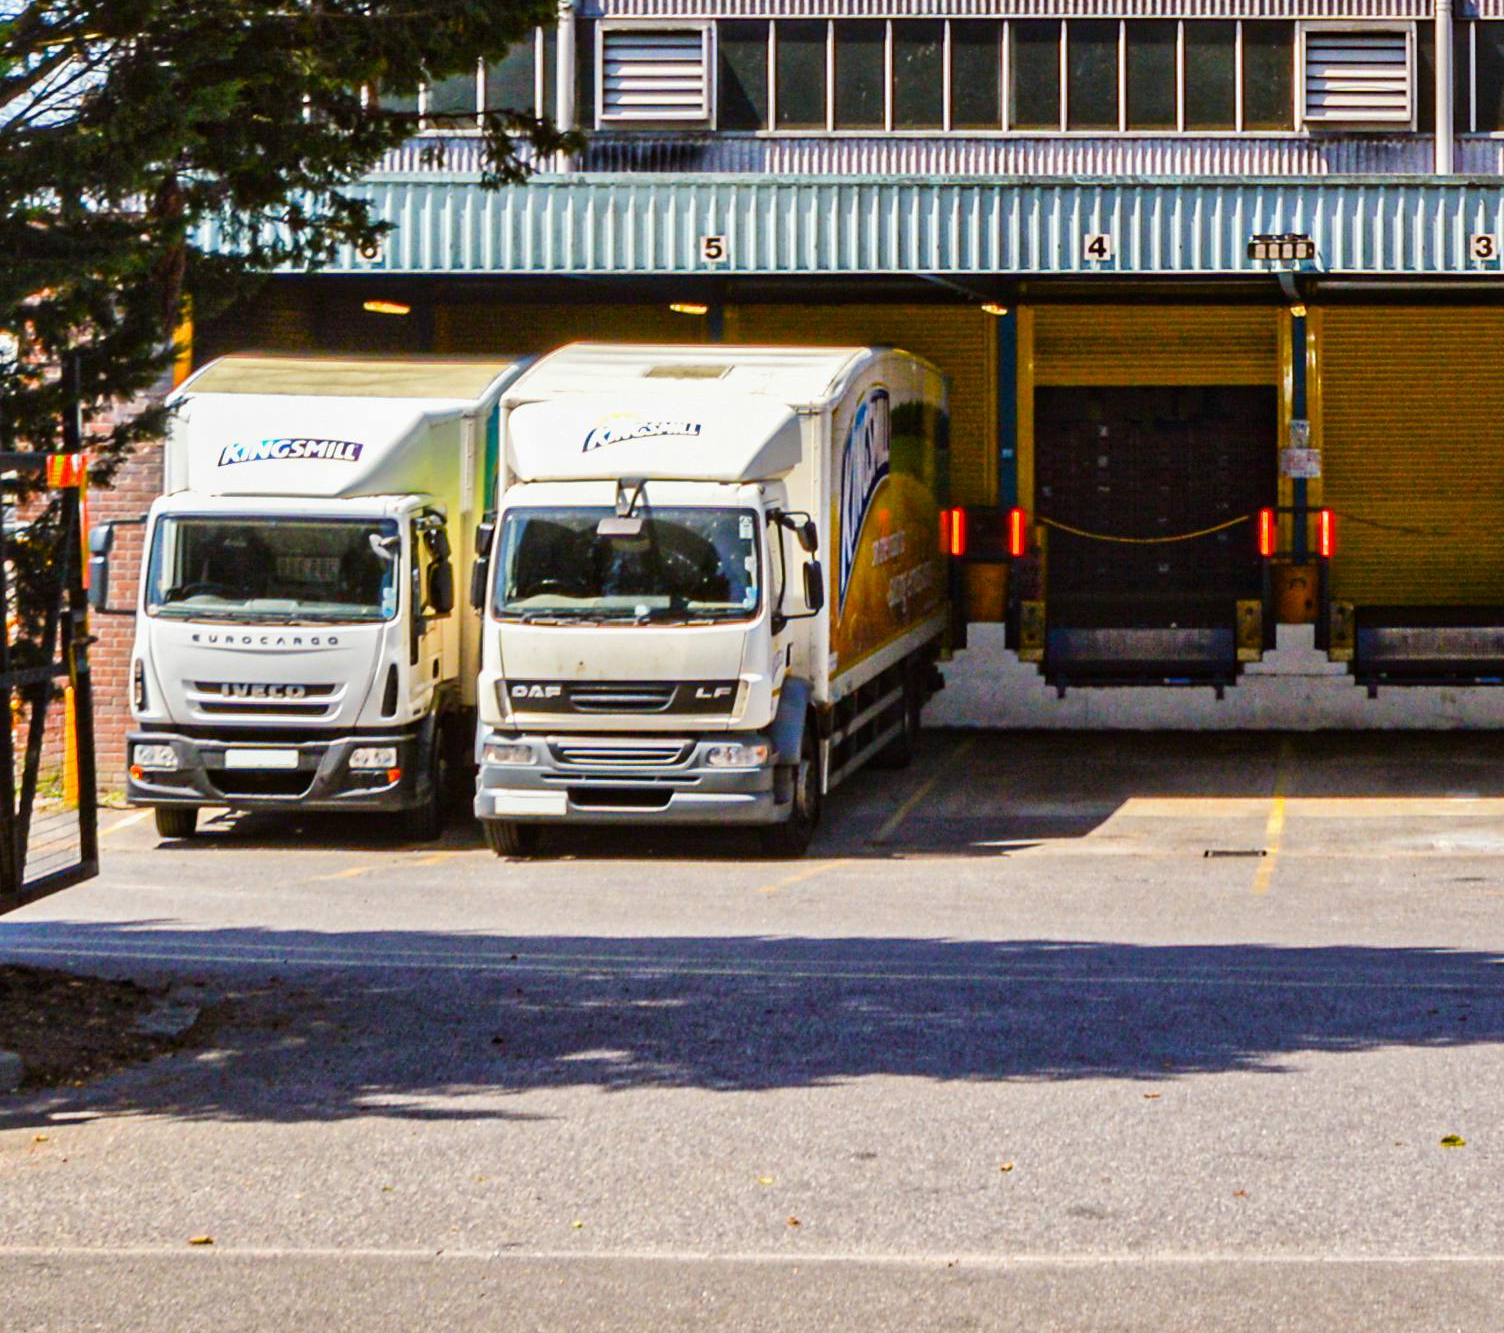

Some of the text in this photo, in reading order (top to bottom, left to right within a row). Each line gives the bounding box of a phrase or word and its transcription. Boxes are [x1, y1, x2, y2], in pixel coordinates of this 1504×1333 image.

[704, 237, 722, 259] 5
[1088, 236, 1107, 258] 4
[1475, 236, 1493, 258] 3
[220, 439, 357, 465] KINGSMILL
[192, 634, 339, 646] EUROCARGO
[221, 684, 306, 698] IVECO
[511, 685, 561, 699] DAF
[695, 686, 732, 699] LF
